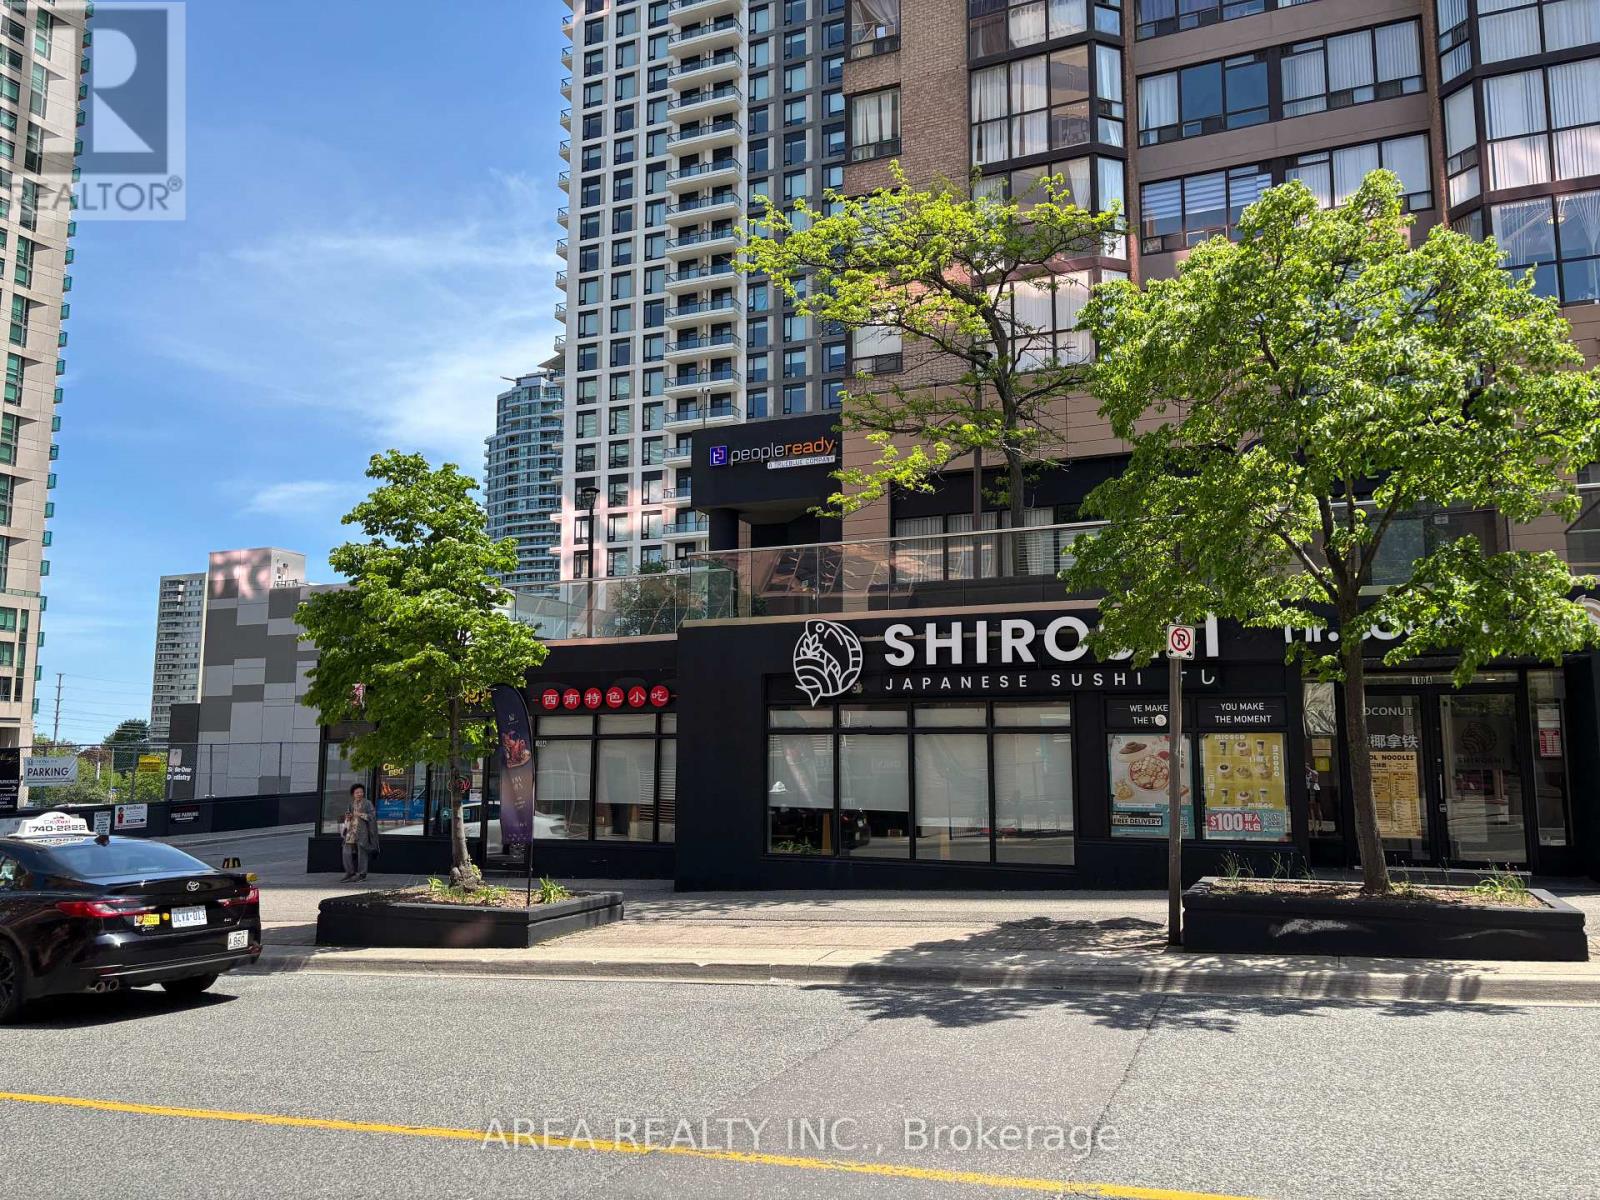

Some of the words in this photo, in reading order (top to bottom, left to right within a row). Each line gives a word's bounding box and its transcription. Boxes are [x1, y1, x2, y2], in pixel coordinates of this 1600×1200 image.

[730, 436, 835, 467] peopleready
[884, 611, 1220, 667] SHIROI
[885, 674, 1028, 691] JAPANESE
[1051, 672, 1142, 688] SUSHI
[543, 690, 668, 705] 西南特色小吃
[1130, 704, 1143, 712] WE
[1145, 704, 1169, 712] MAKE
[1220, 703, 1238, 711] YOU
[1240, 702, 1264, 710] MAKE
[1365, 706, 1414, 716] OCONUT
[1132, 716, 1148, 725] THE
[1215, 715, 1232, 723] THE
[1234, 715, 1272, 723] MOMENT
[1369, 733, 1419, 749] 椰拿铁
[27, 767, 69, 777] PARKING
[1113, 817, 1129, 825] FREE
[1130, 817, 1161, 825] DELIVERY
[1210, 812, 1244, 831] $100
